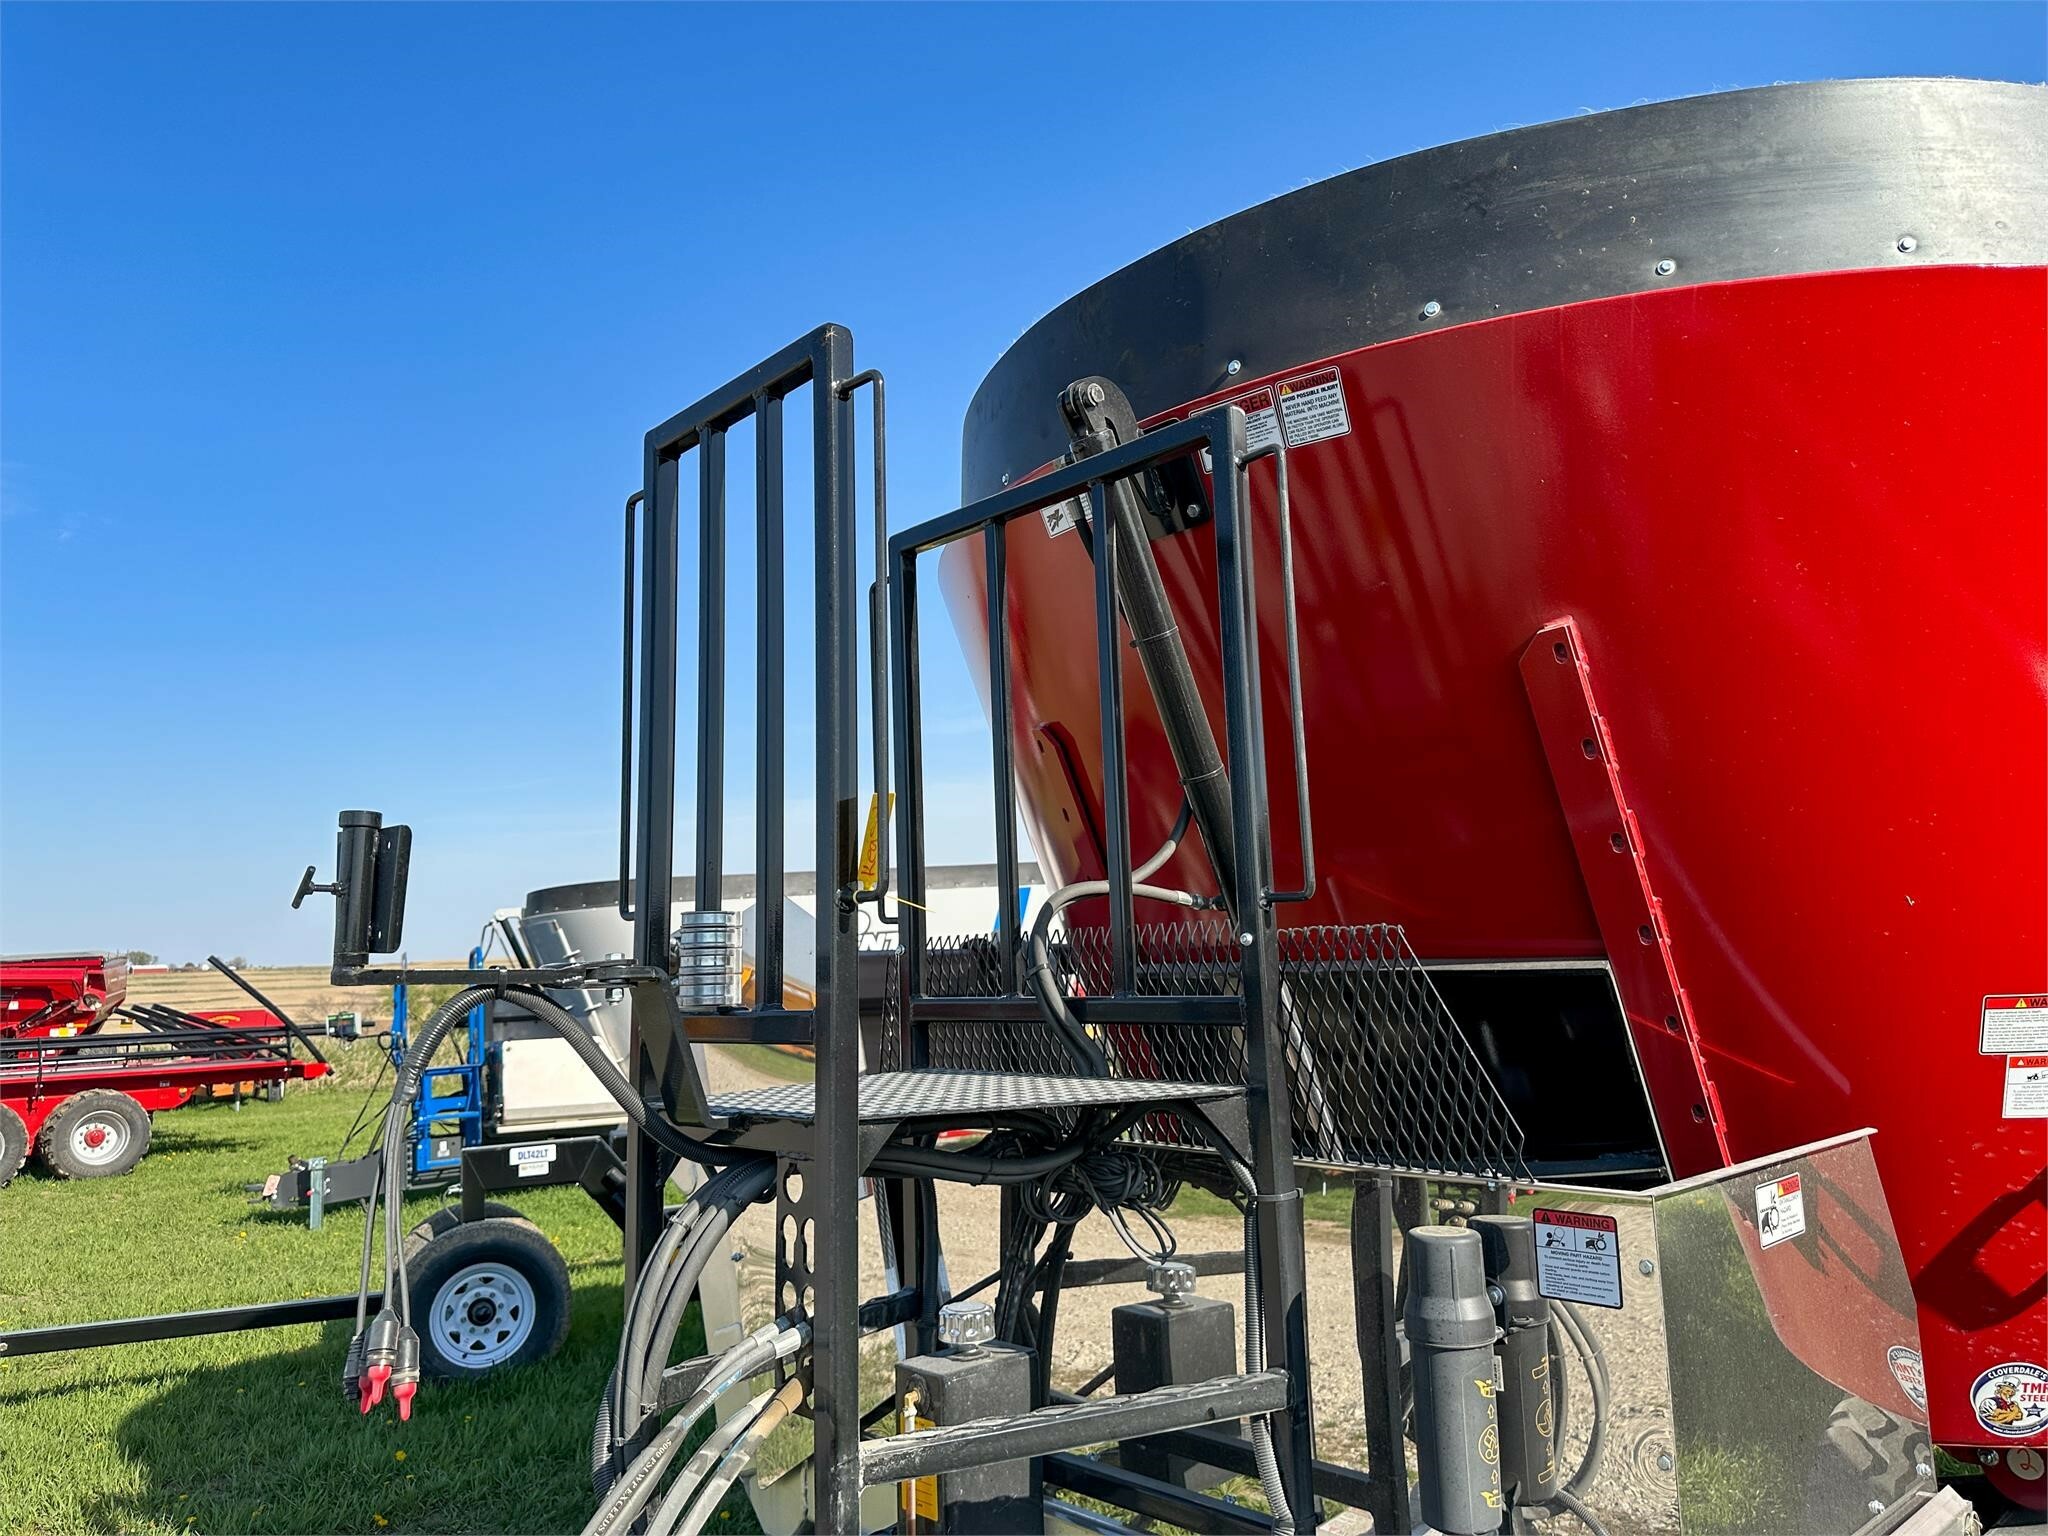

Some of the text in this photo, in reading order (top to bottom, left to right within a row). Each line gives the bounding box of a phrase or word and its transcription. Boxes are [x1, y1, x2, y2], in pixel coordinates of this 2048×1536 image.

[1290, 371, 1337, 392] WARNING
[1281, 383, 1338, 403] AVOID POSSIBLE INJURY
[1284, 398, 1340, 418] MATERIAL INTO MACHINE
[1285, 402, 1300, 411] NEVER
[1314, 395, 1328, 403] FEED
[517, 1149, 549, 1160] DLT42LT
[1554, 1214, 1609, 1230] WARNING
[1988, 1366, 2048, 1380] CLOVERDALE'S
[598, 1438, 672, 1533] 5000 PSI WP EXCEEDS
